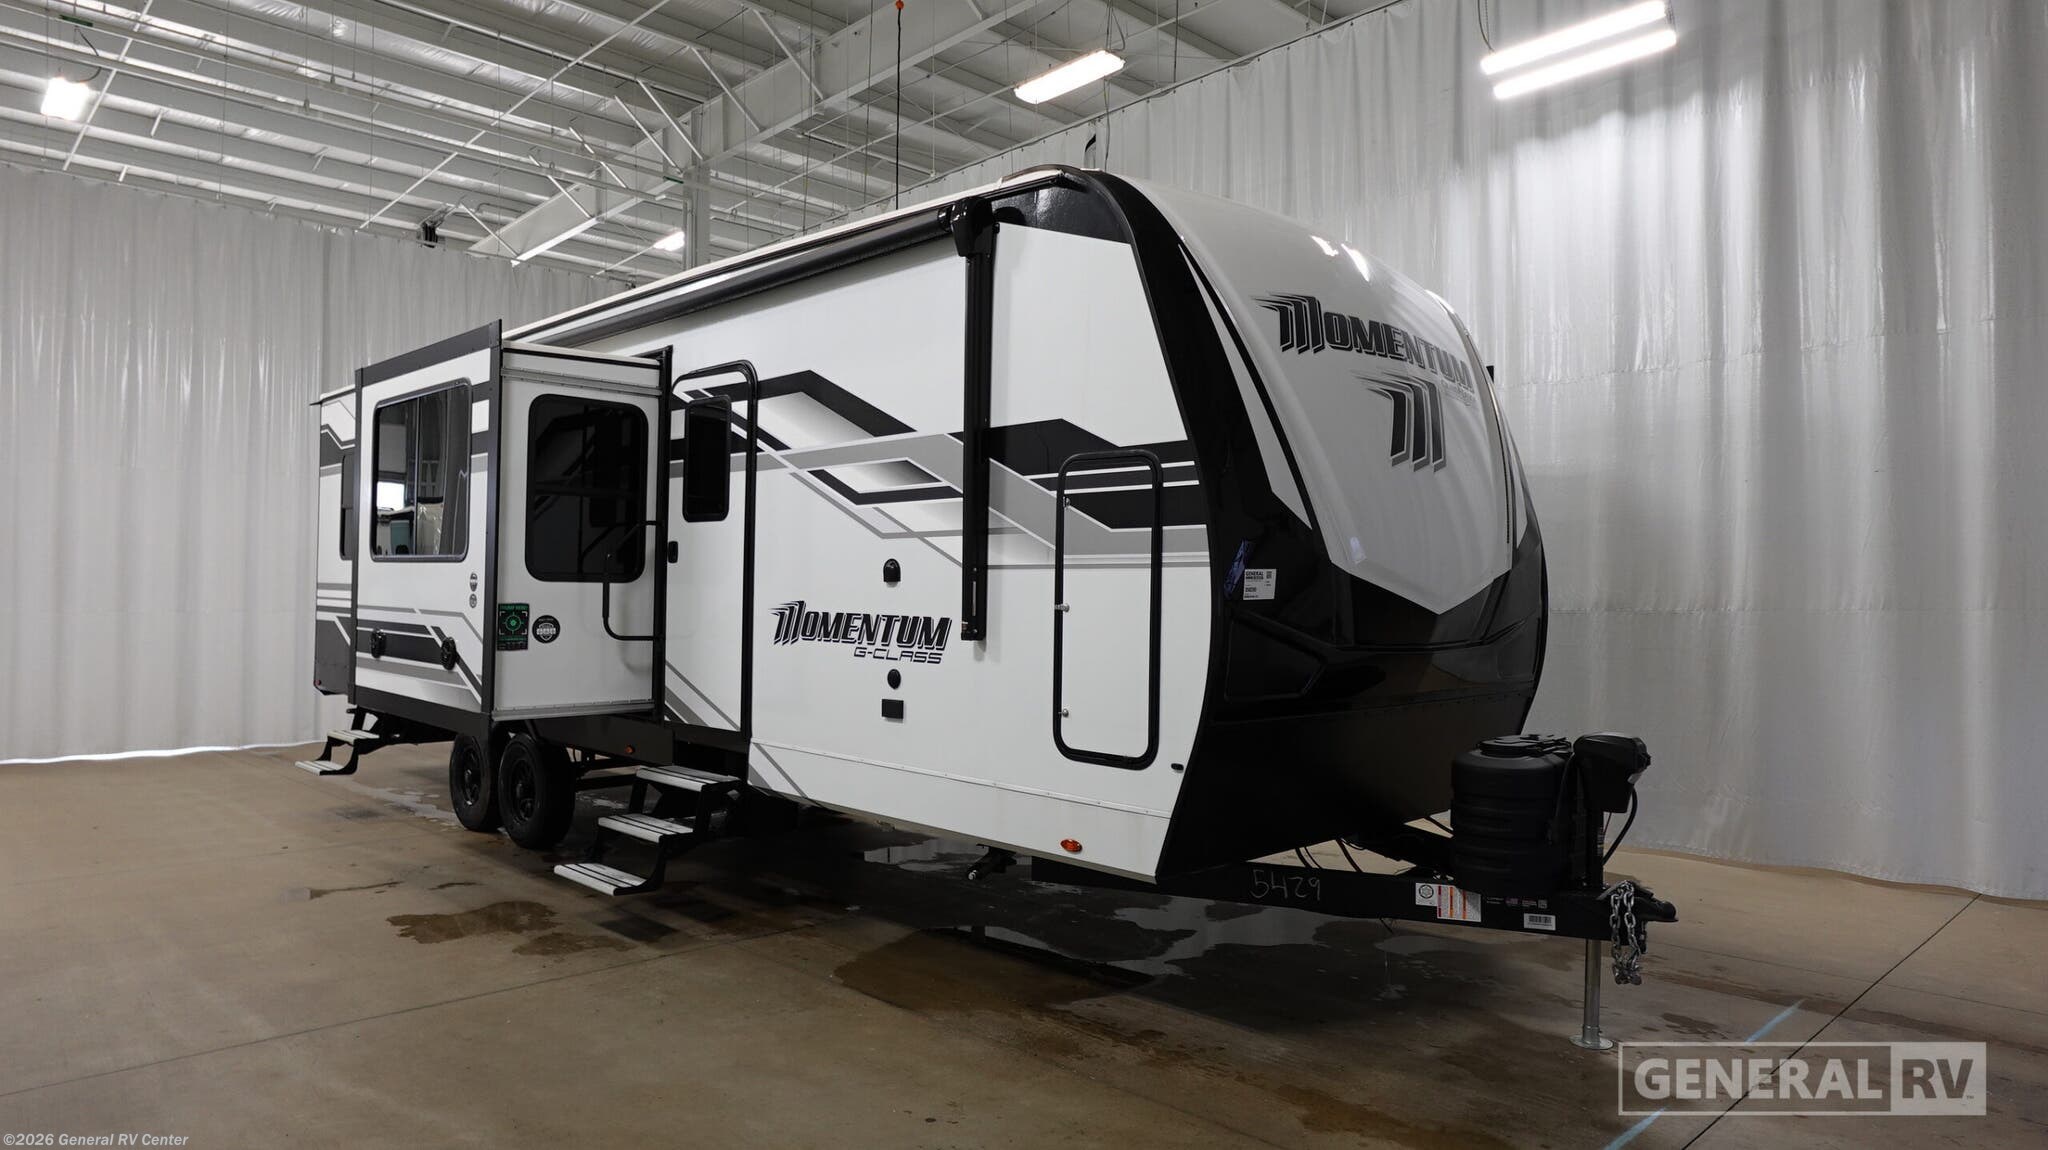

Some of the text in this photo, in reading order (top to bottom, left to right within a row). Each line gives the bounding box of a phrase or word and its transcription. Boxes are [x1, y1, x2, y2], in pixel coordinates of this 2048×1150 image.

[1254, 293, 1475, 394] MOMENTUM
[770, 600, 952, 651] MOMENTUM
[853, 647, 943, 664] G-CLASS
[1250, 869, 1321, 900] 5429
